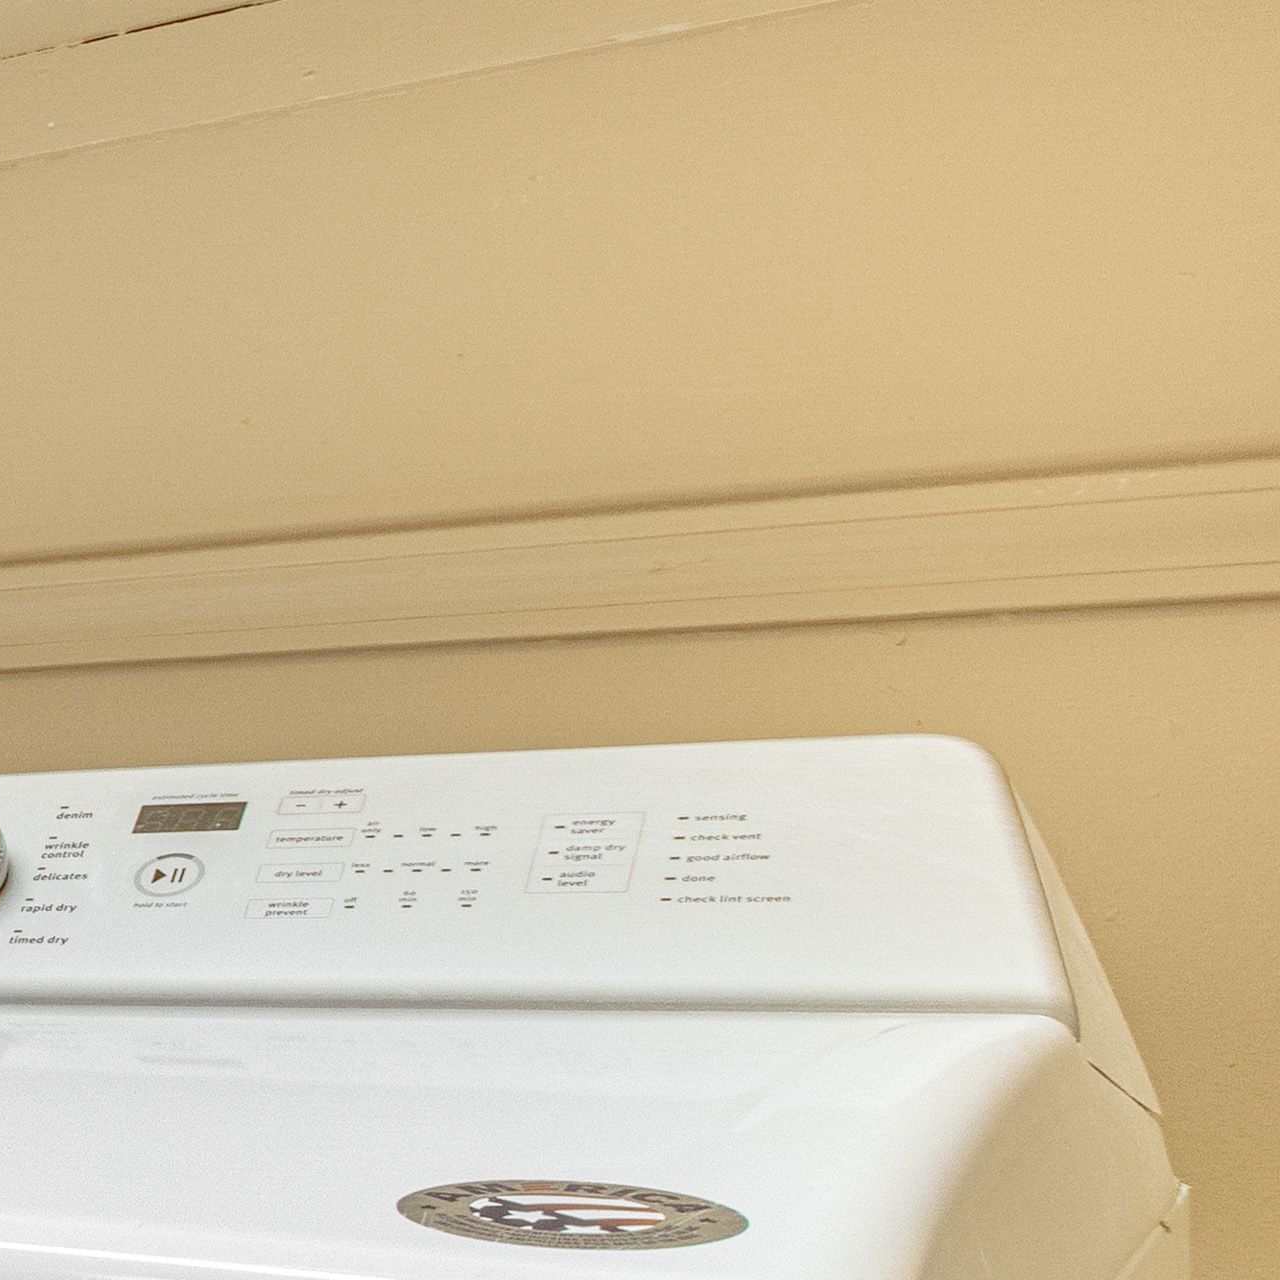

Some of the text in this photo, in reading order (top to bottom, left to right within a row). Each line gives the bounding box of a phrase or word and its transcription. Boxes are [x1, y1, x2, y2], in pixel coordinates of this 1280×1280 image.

[56, 811, 94, 820] denim
[694, 814, 748, 822] sensing
[276, 834, 344, 844] temperature
[44, 841, 90, 850] wrinkle
[566, 844, 626, 852] damp dry
[41, 850, 85, 859] control
[564, 853, 602, 862] signal
[686, 853, 771, 863] good airflow
[32, 872, 89, 882] delicates
[274, 869, 323, 878] dry level
[268, 900, 310, 908] wrinkle
[20, 904, 78, 914] rapid dry
[265, 909, 308, 918] prevent
[8, 936, 68, 946] timed dry
[422, 1182, 712, 1214] AMERICA
